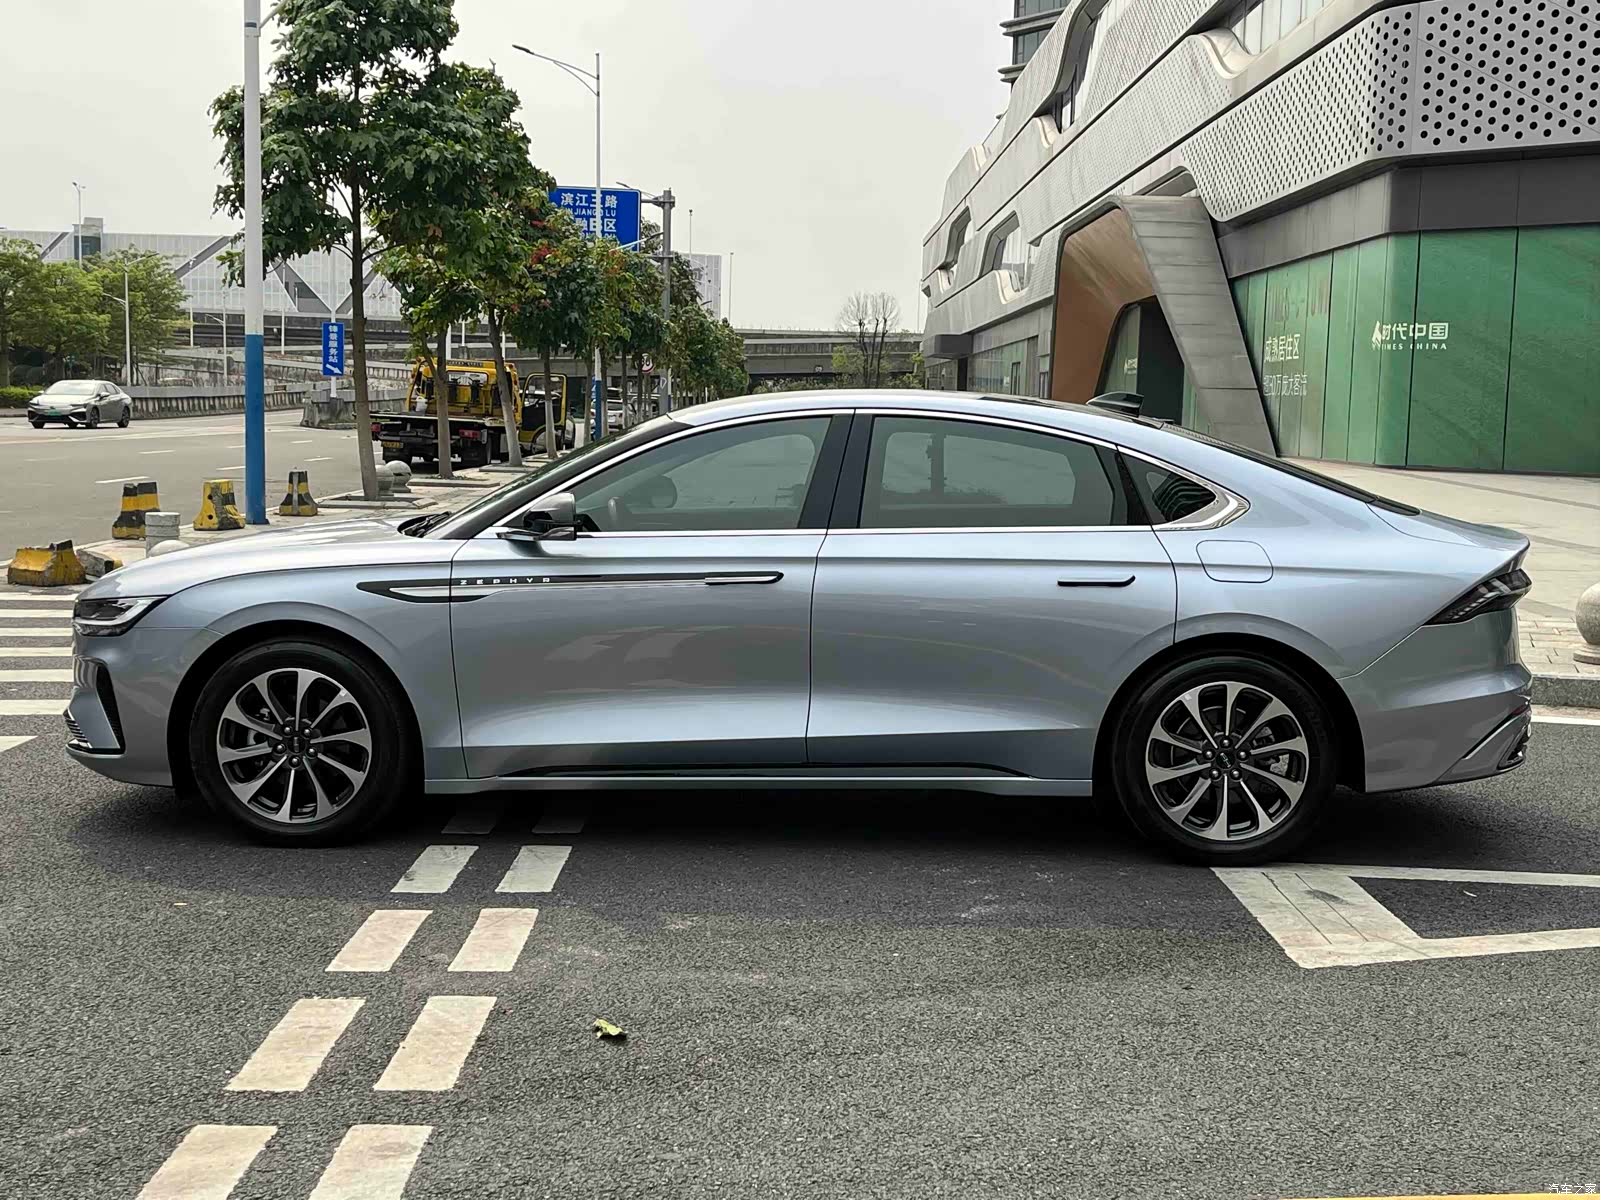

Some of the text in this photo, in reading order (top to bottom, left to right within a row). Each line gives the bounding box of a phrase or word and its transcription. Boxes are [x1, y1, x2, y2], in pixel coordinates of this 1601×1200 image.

[1381, 322, 1449, 341] 时代中国
[460, 577, 550, 585] ZEPHYR
